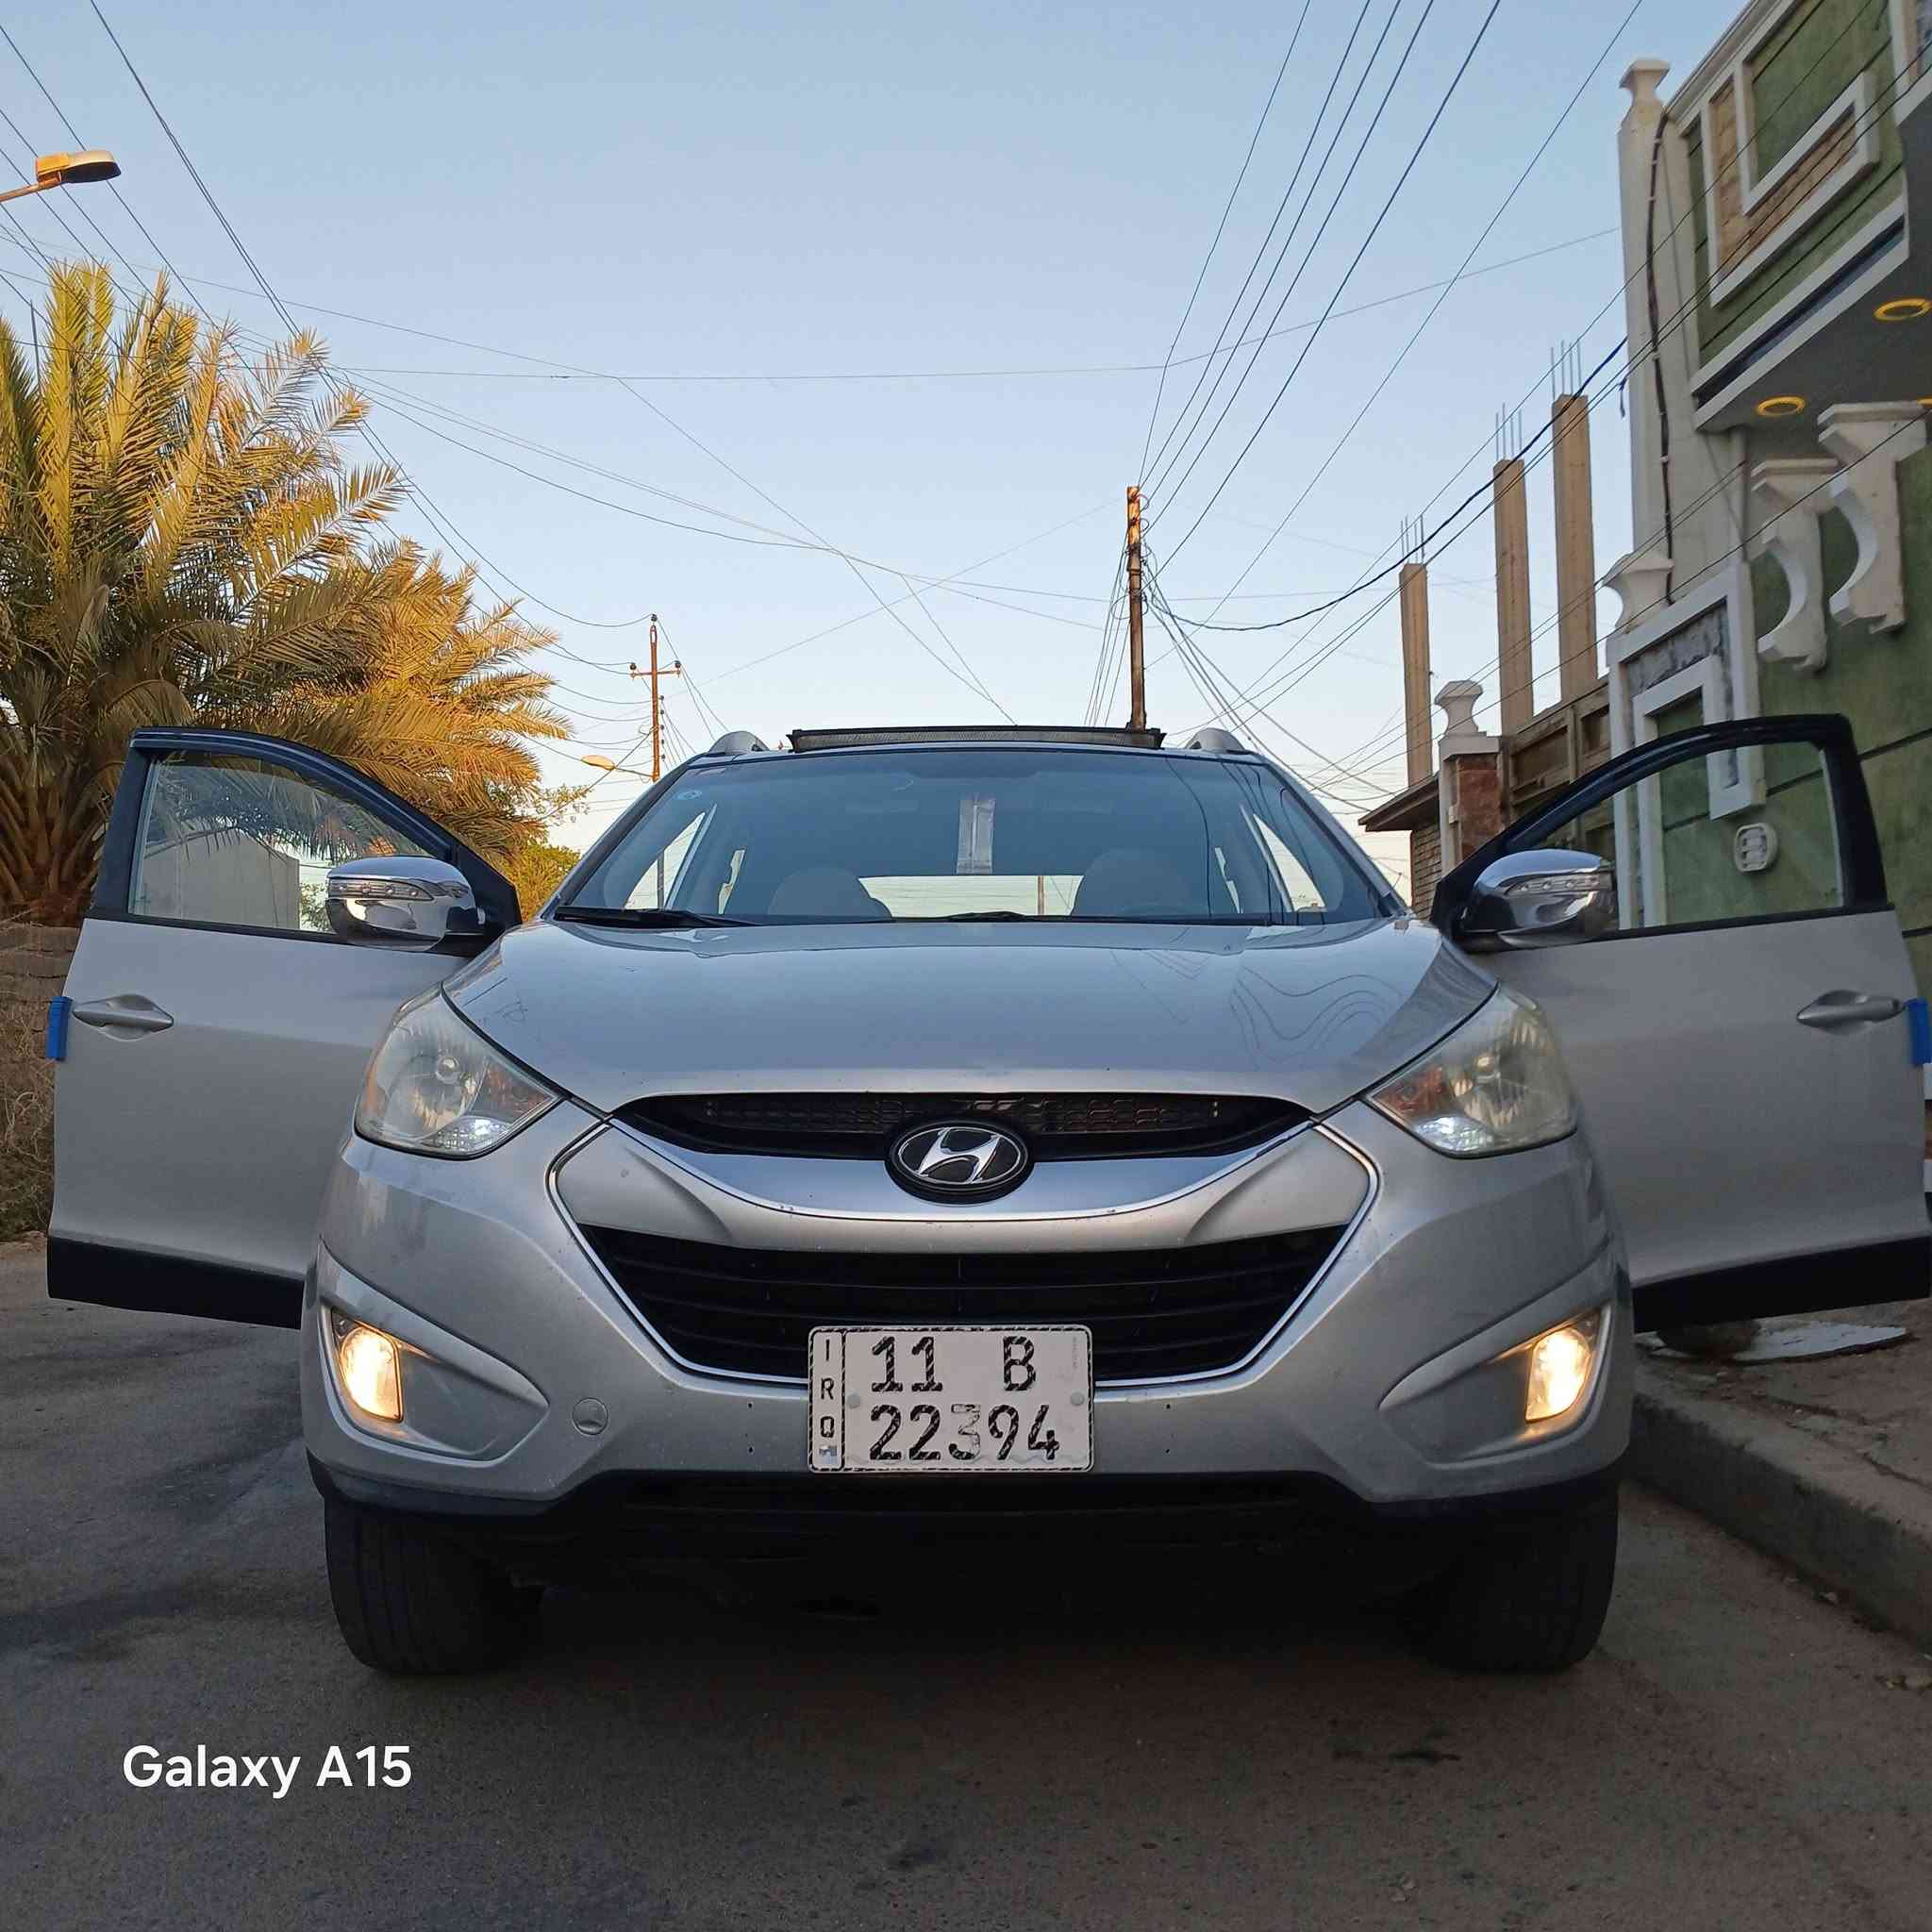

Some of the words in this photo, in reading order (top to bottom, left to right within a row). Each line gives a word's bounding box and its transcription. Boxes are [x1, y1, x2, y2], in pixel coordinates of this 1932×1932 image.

[871, 1335, 943, 1392] 11
[1002, 1335, 1037, 1391] B
[869, 1403, 1060, 1461] 22394
